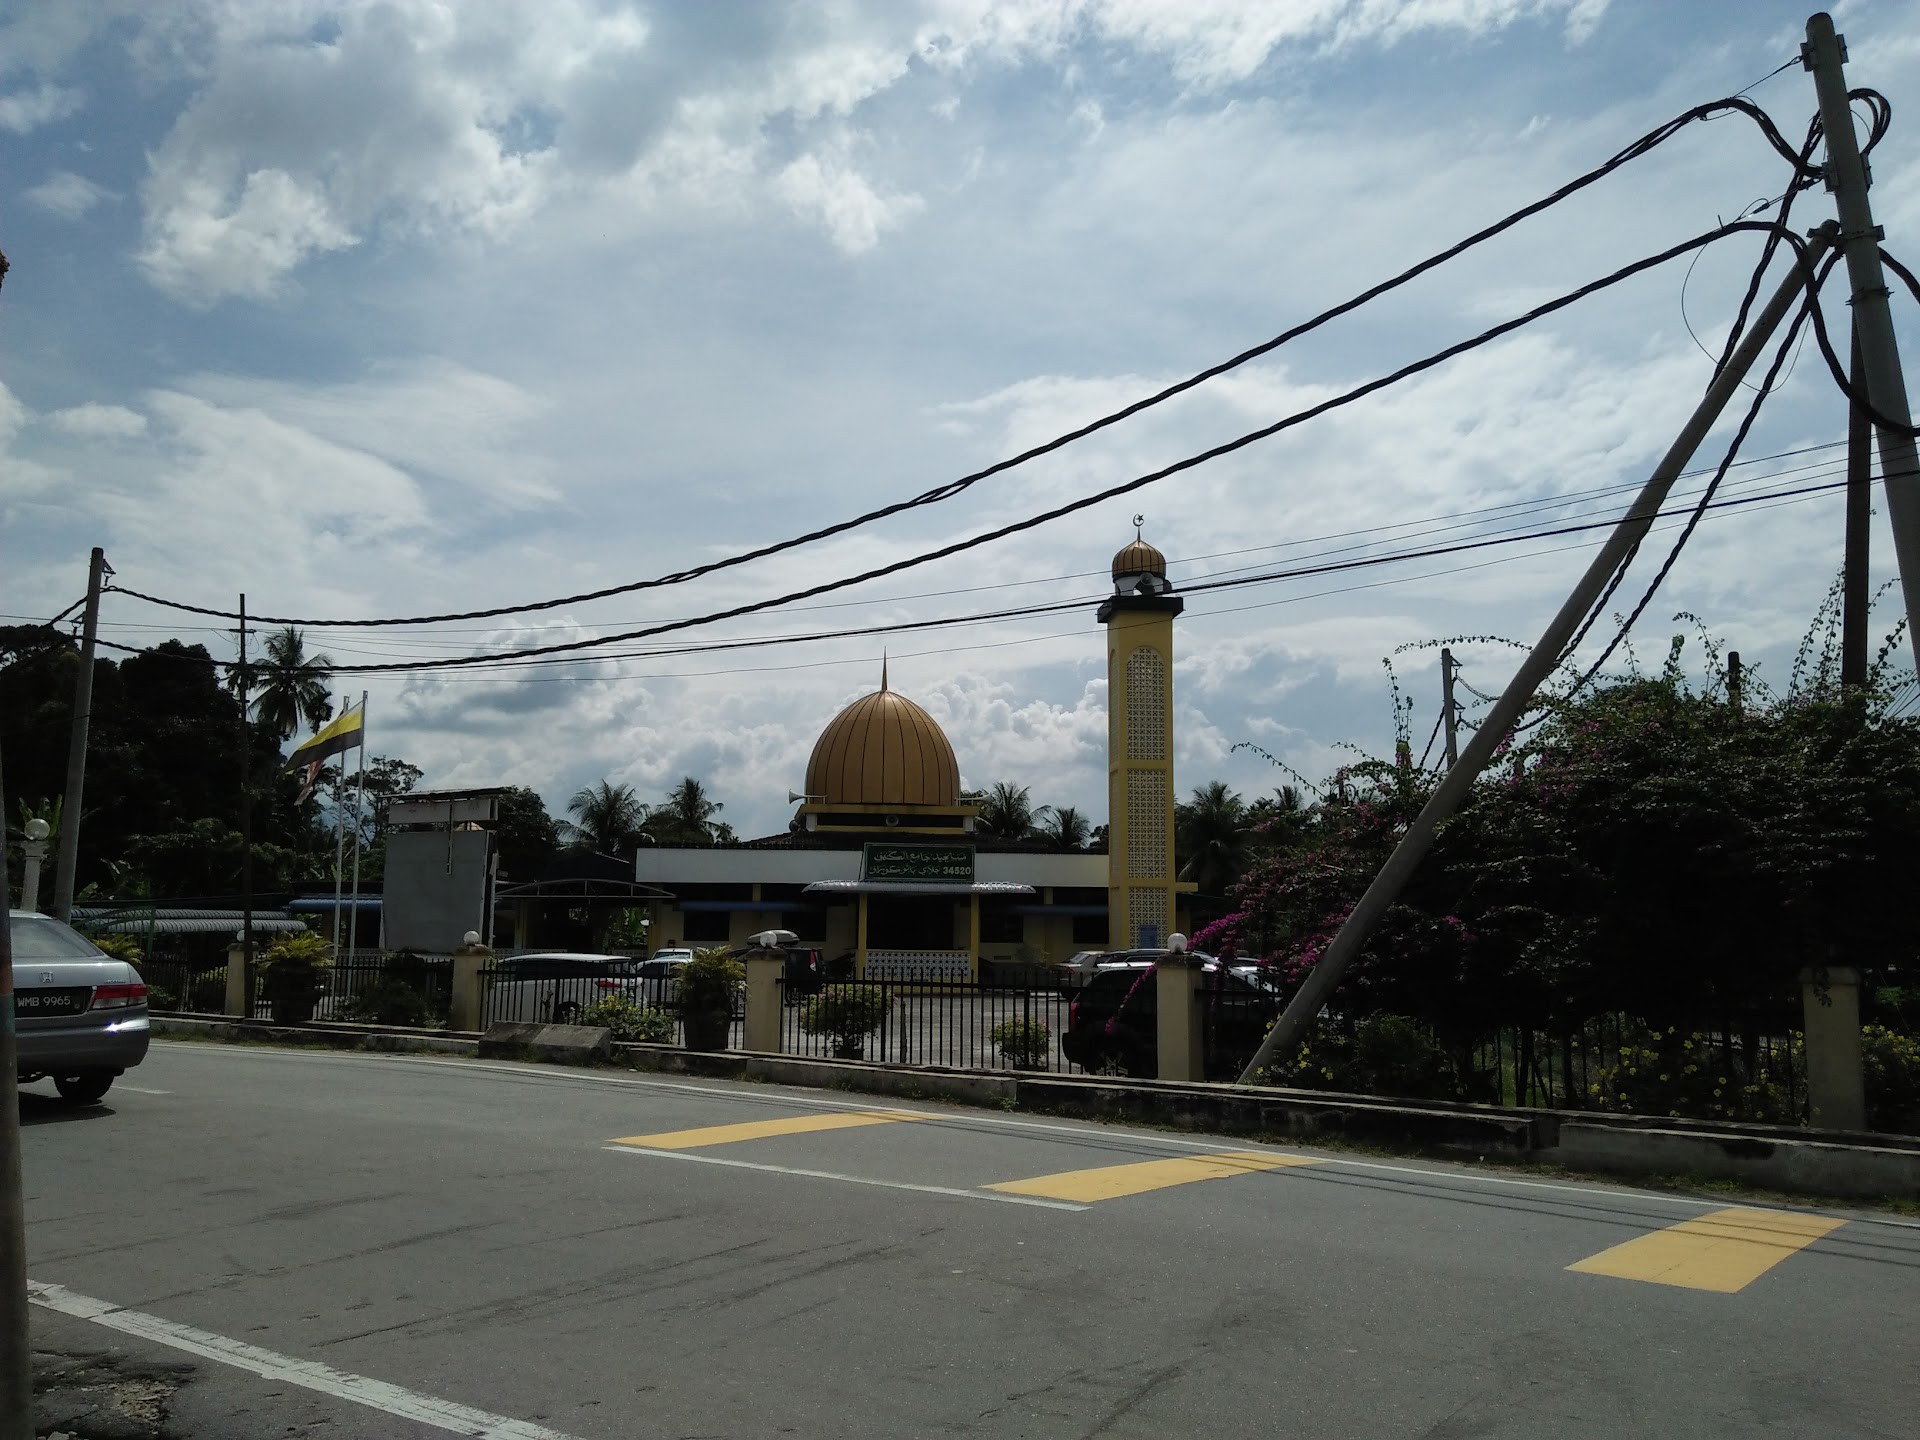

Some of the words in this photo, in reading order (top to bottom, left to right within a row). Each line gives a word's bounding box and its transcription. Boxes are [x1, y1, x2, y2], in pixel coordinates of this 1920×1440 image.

[943, 866, 971, 875] 34520
[17, 997, 40, 1007] WMB
[43, 996, 71, 1006] 9965
